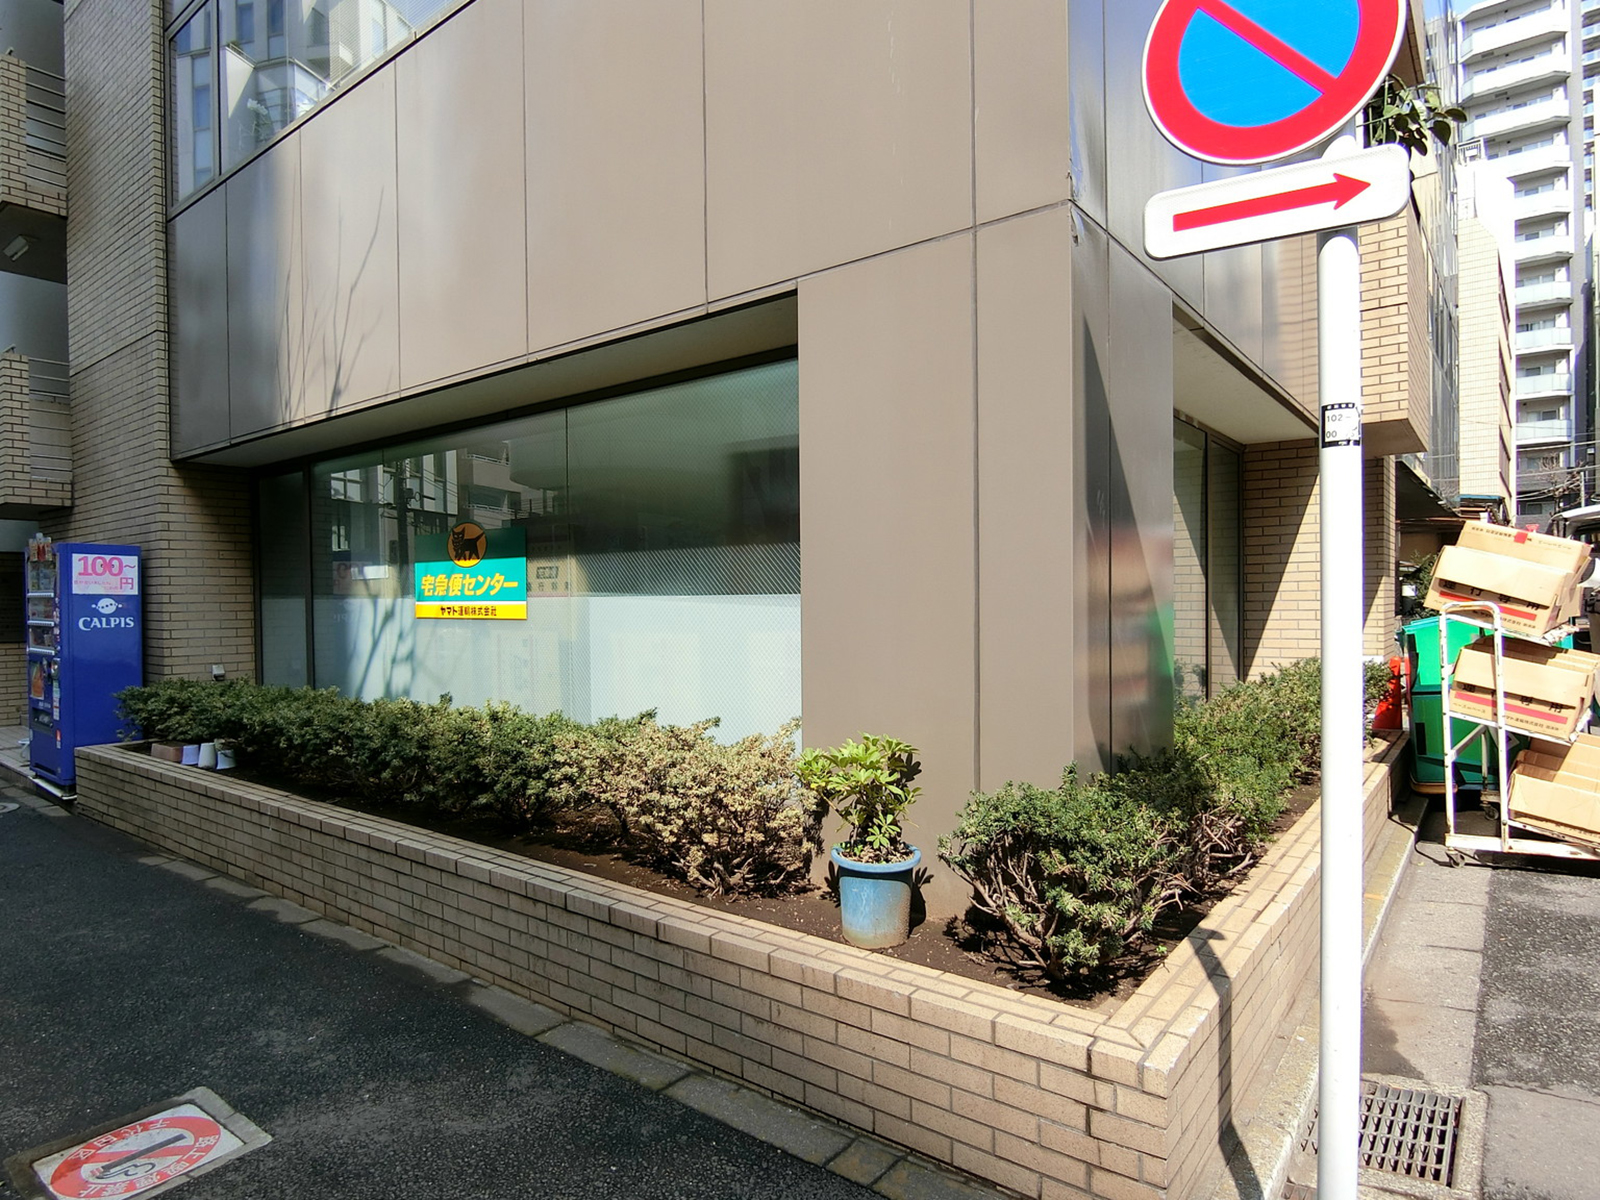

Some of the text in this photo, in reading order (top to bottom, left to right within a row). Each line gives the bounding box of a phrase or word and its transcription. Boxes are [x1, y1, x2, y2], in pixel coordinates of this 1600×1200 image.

[120, 577, 134, 590] 円
[421, 572, 519, 597] 宅急便センター
[440, 605, 497, 617] ヤマト運輸株式会社
[78, 616, 135, 631] CALPIS
[68, 1119, 171, 1160] 千代田区
[79, 1135, 220, 1198] 路上喫煙禁止
